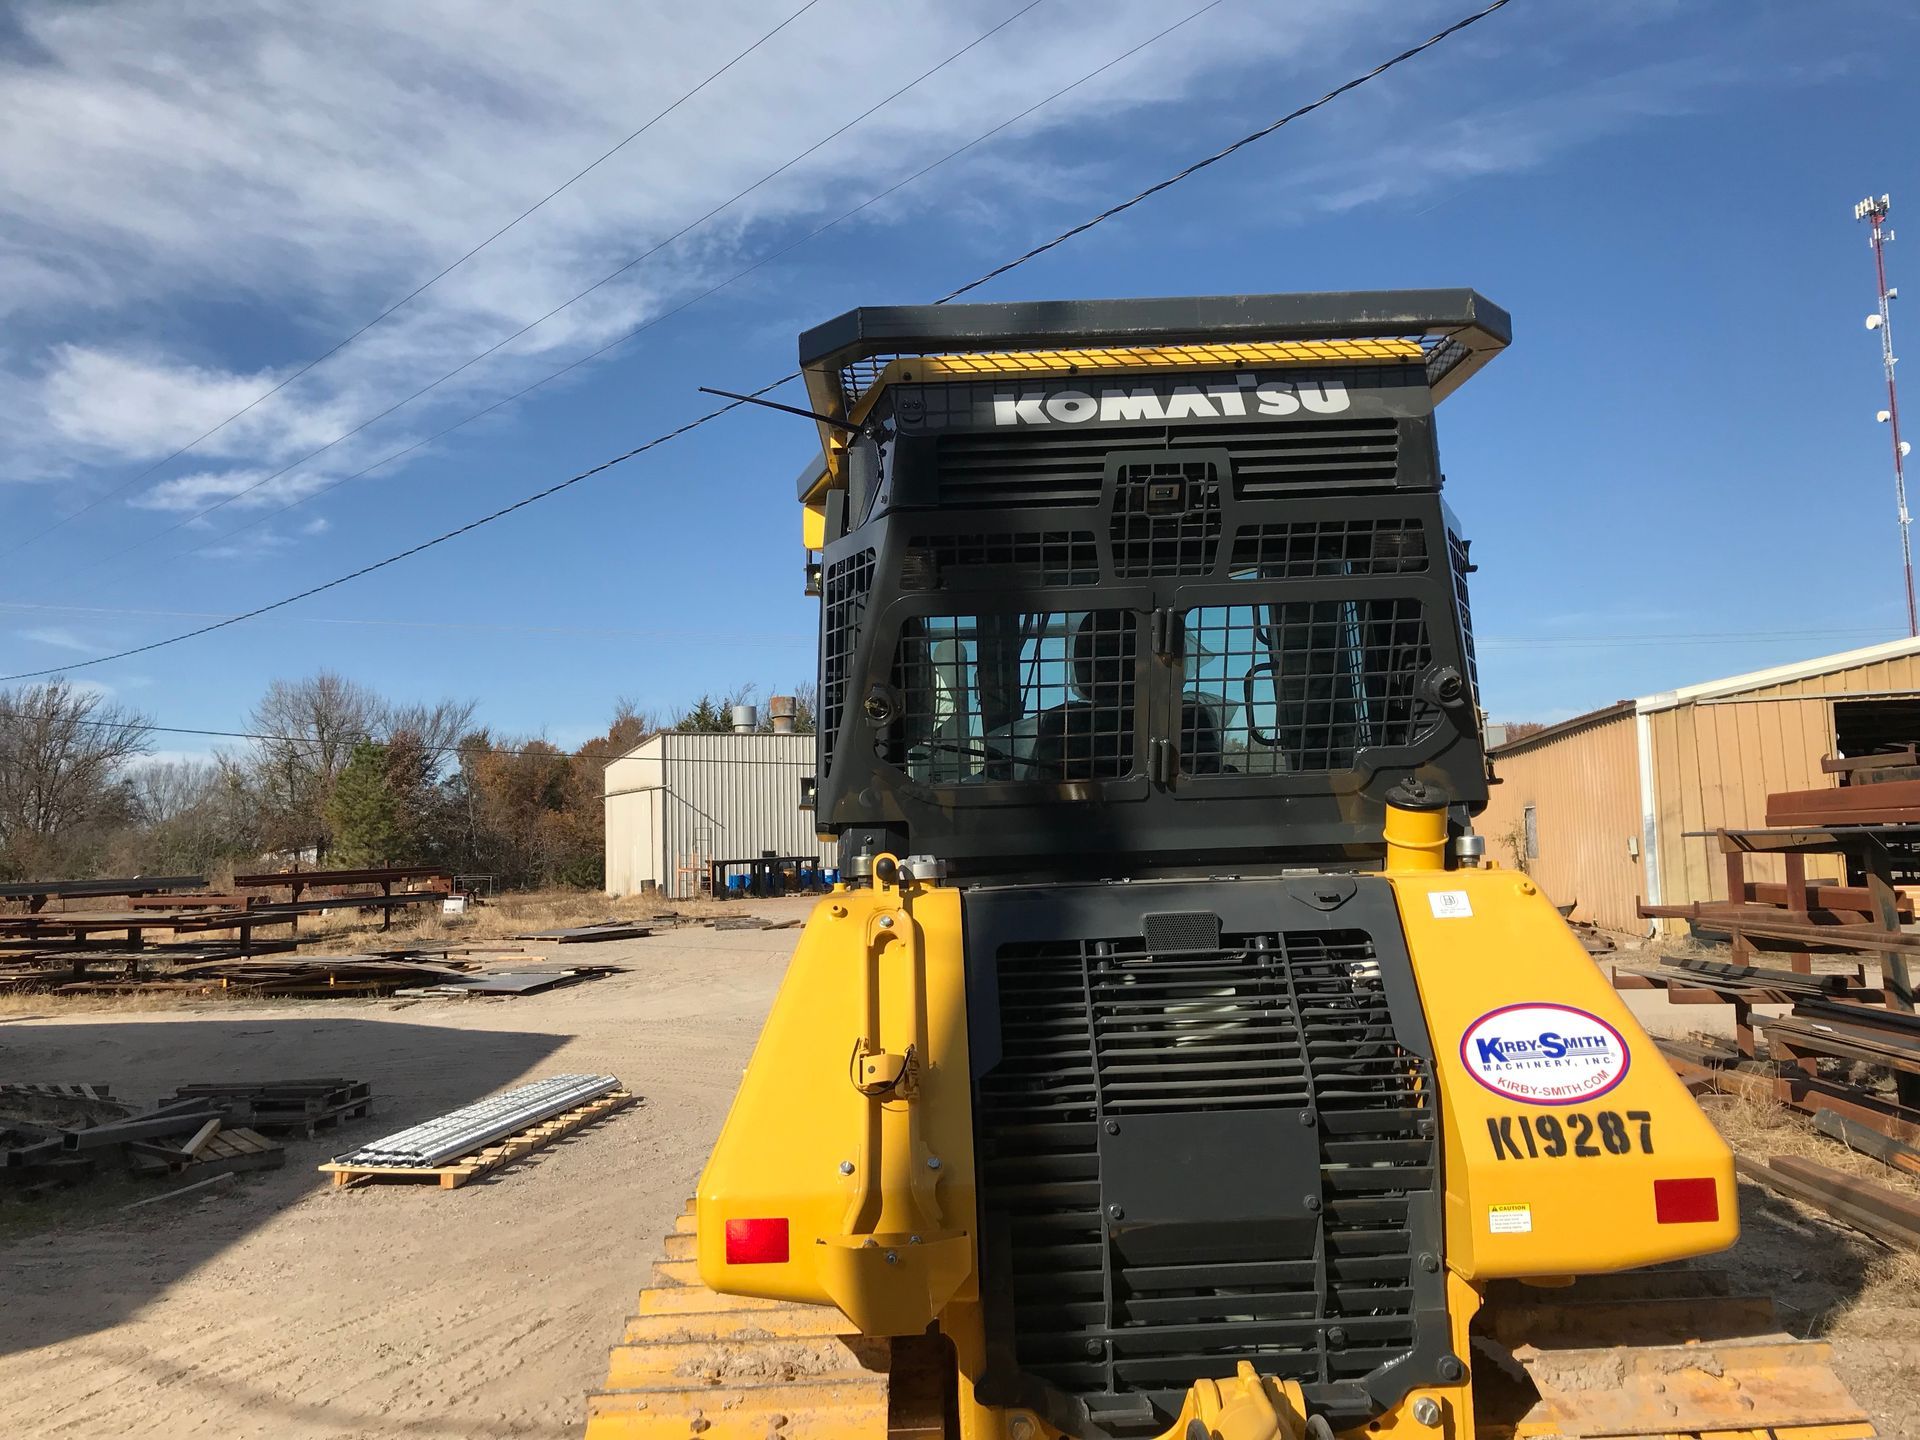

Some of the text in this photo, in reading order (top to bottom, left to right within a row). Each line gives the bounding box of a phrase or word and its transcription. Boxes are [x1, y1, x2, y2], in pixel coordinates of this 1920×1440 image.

[993, 374, 1351, 426] KOMATSU
[1475, 1032, 1608, 1064] KIRBY-SMITH
[1497, 1069, 1611, 1097] KIRBY-SMITH.COM
[1498, 1204, 1527, 1213] CAUTION
